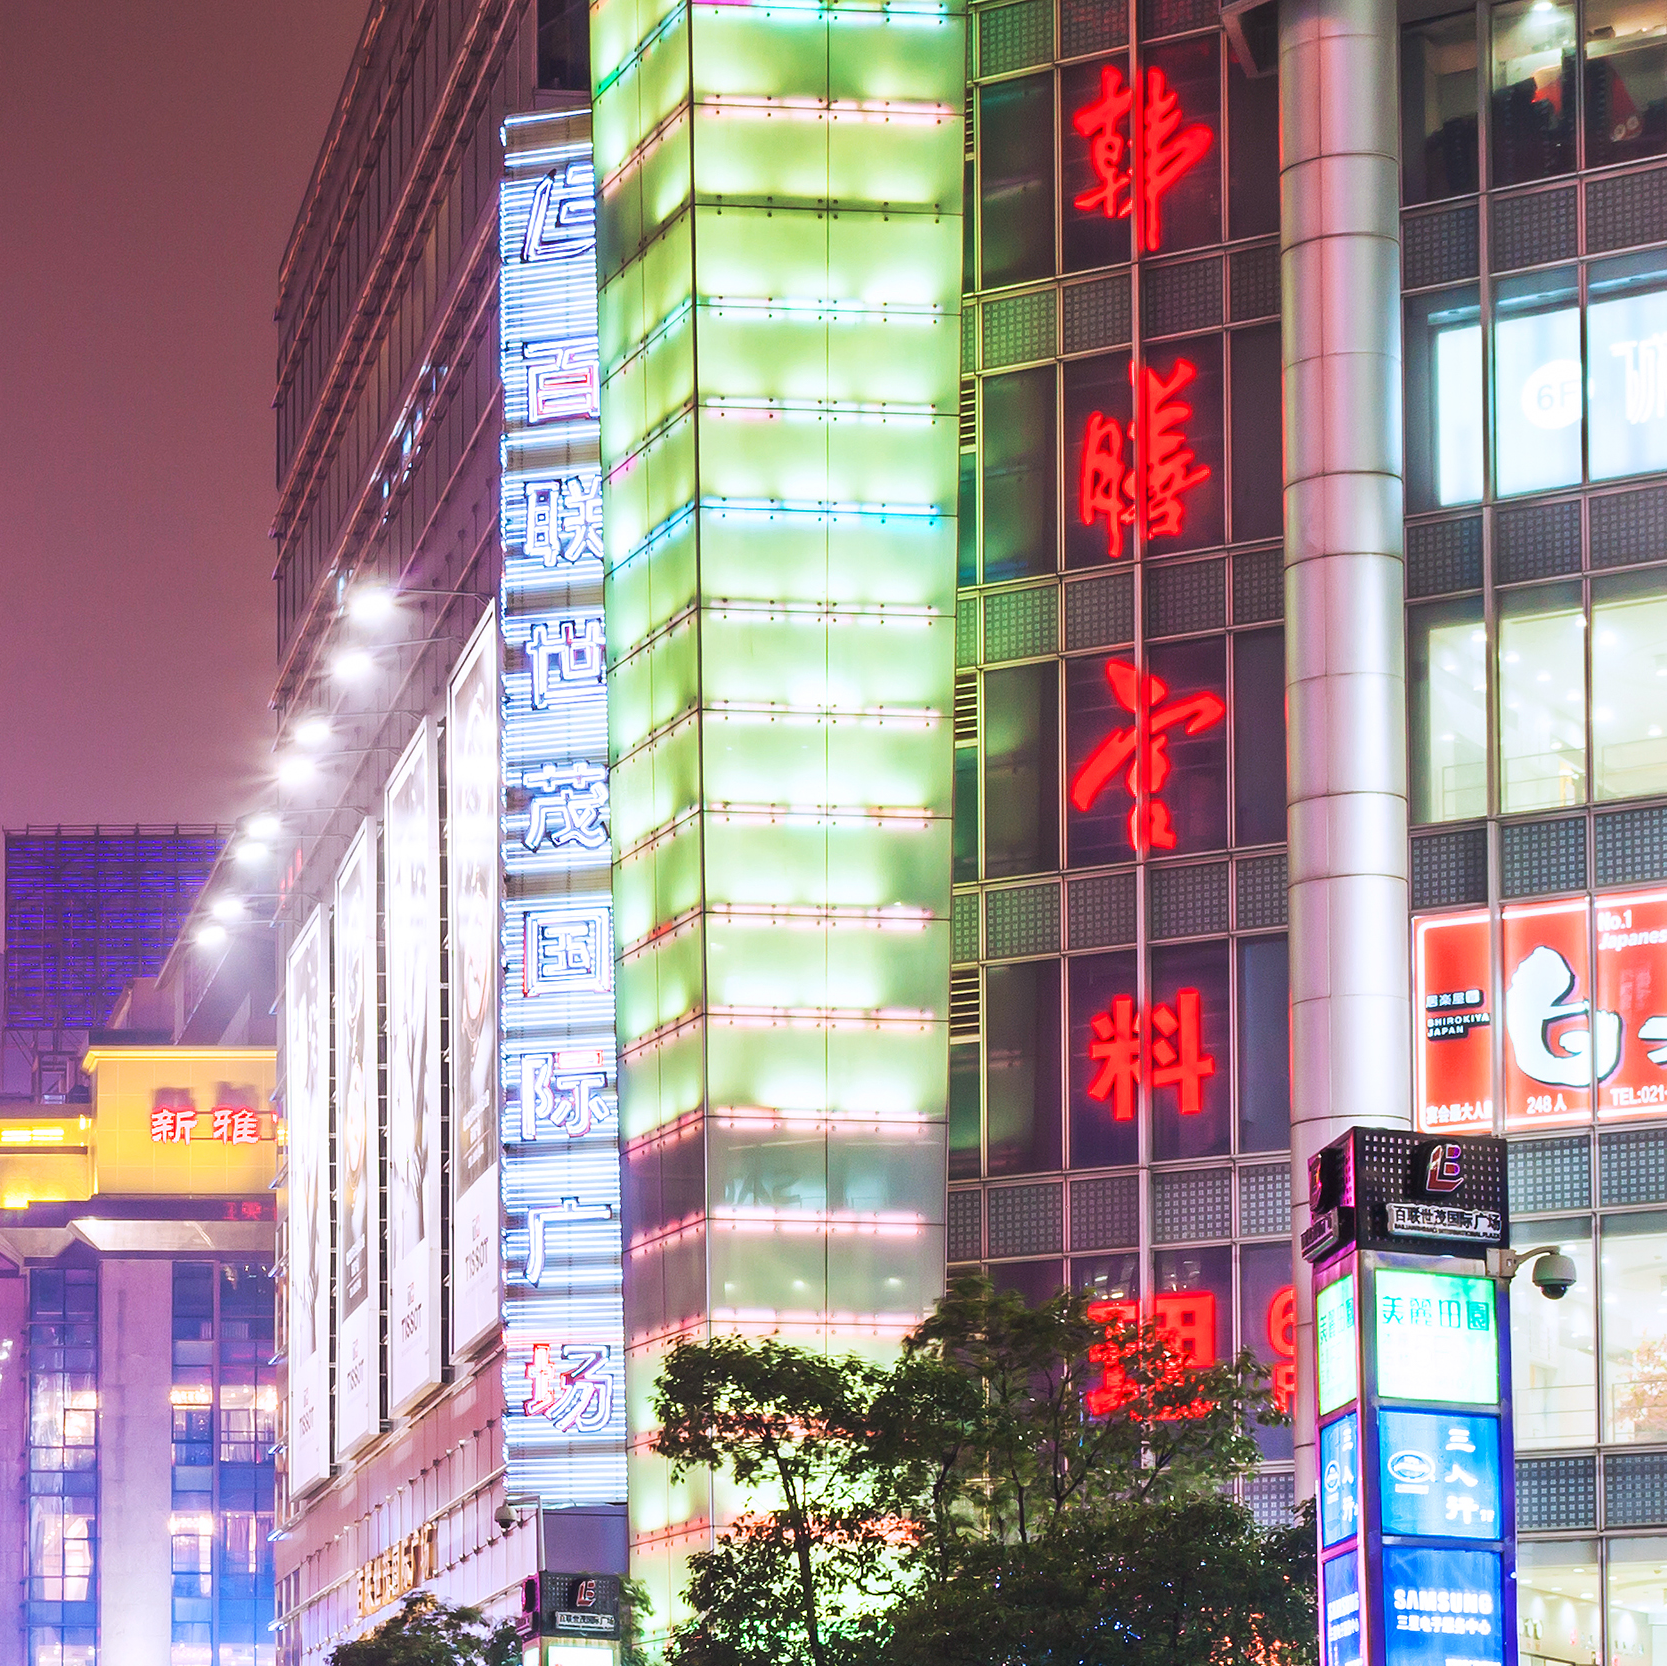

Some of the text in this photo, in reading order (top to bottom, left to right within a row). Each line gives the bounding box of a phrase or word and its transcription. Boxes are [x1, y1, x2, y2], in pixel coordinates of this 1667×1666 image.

[1427, 1013, 1490, 1028] SHIROKIYA
[1428, 1026, 1464, 1038] JAPAN
[151, 1106, 277, 1146] 新雅
[1395, 1205, 1501, 1231] 百联世茂国际广场
[1382, 1295, 1490, 1332] 美麗田園
[1394, 1588, 1494, 1614] SAMSUNG
